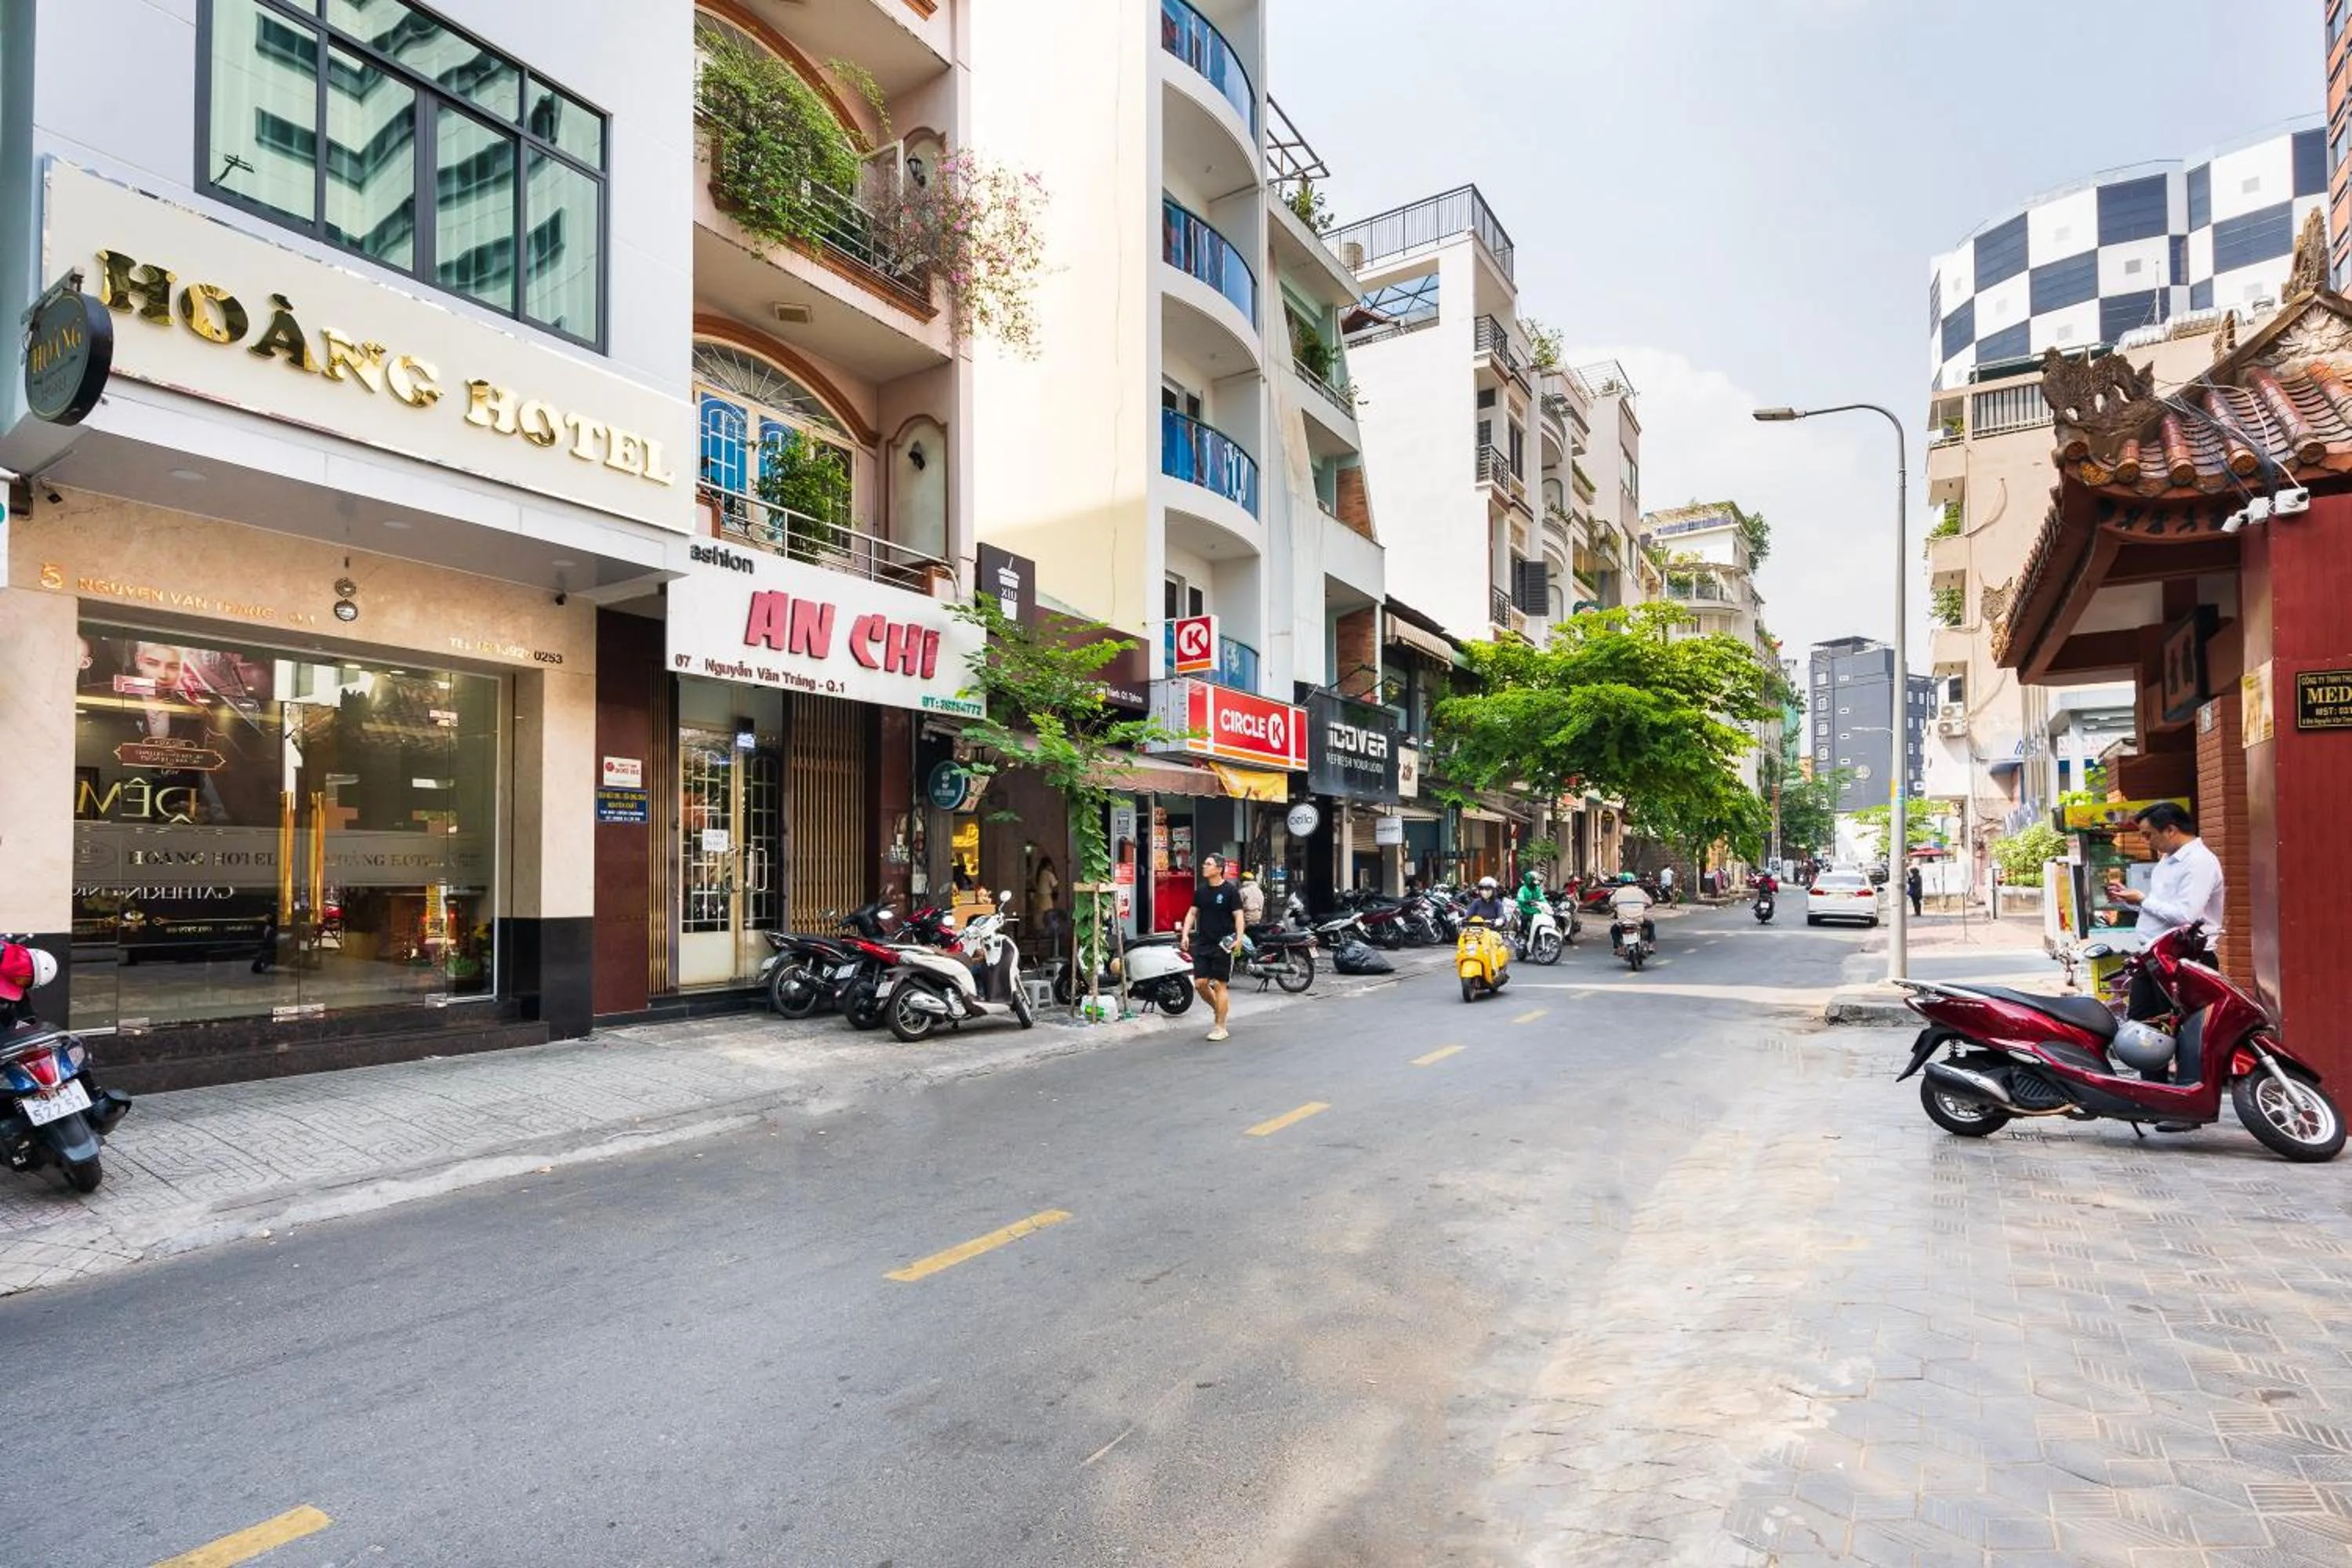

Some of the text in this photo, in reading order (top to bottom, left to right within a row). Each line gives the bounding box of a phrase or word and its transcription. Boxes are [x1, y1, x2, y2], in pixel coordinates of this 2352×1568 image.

[95, 249, 675, 486] HOÀNG HOTEL
[690, 544, 754, 574] ashion
[38, 562, 64, 589] 5
[744, 590, 940, 680] AN CHI
[1184, 626, 1207, 654] K
[675, 653, 691, 667] 07
[826, 679, 845, 693] Q.1
[1219, 708, 1267, 739] CIRCLE
